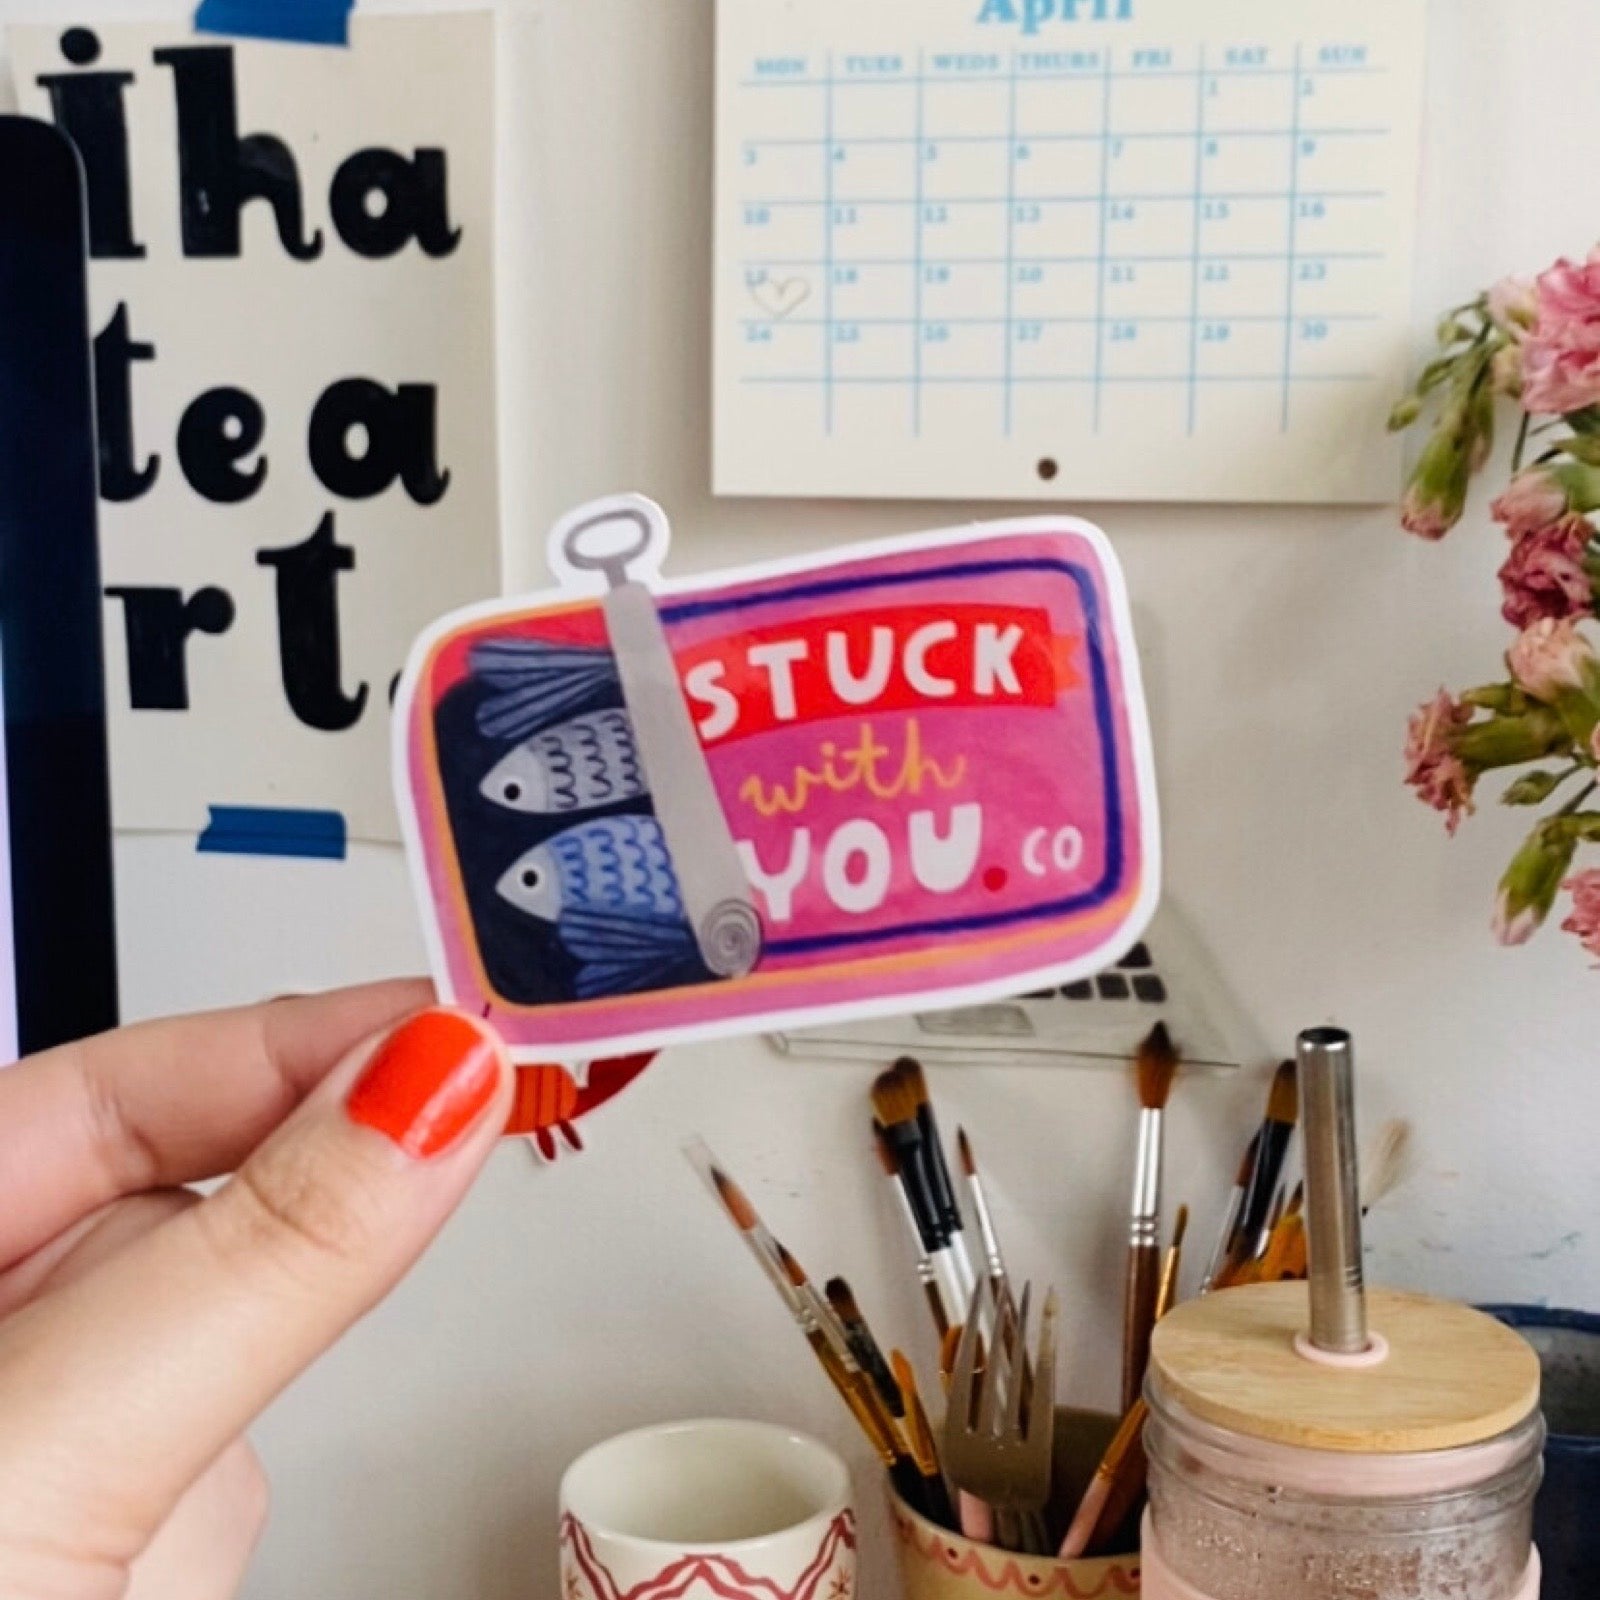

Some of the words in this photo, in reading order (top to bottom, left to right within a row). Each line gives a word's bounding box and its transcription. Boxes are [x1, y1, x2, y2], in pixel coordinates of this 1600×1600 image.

[755, 58, 805, 75] MON
[845, 54, 903, 73] TUES
[933, 54, 999, 71] WEDS
[1018, 52, 1099, 69] THURS
[1133, 50, 1171, 67] FRI
[1226, 48, 1268, 65] SAT
[1320, 46, 1368, 63] SUN
[975, 0, 1132, 34] April
[93, 301, 450, 506] tea
[685, 620, 1024, 740] STUCK
[739, 717, 967, 816] with
